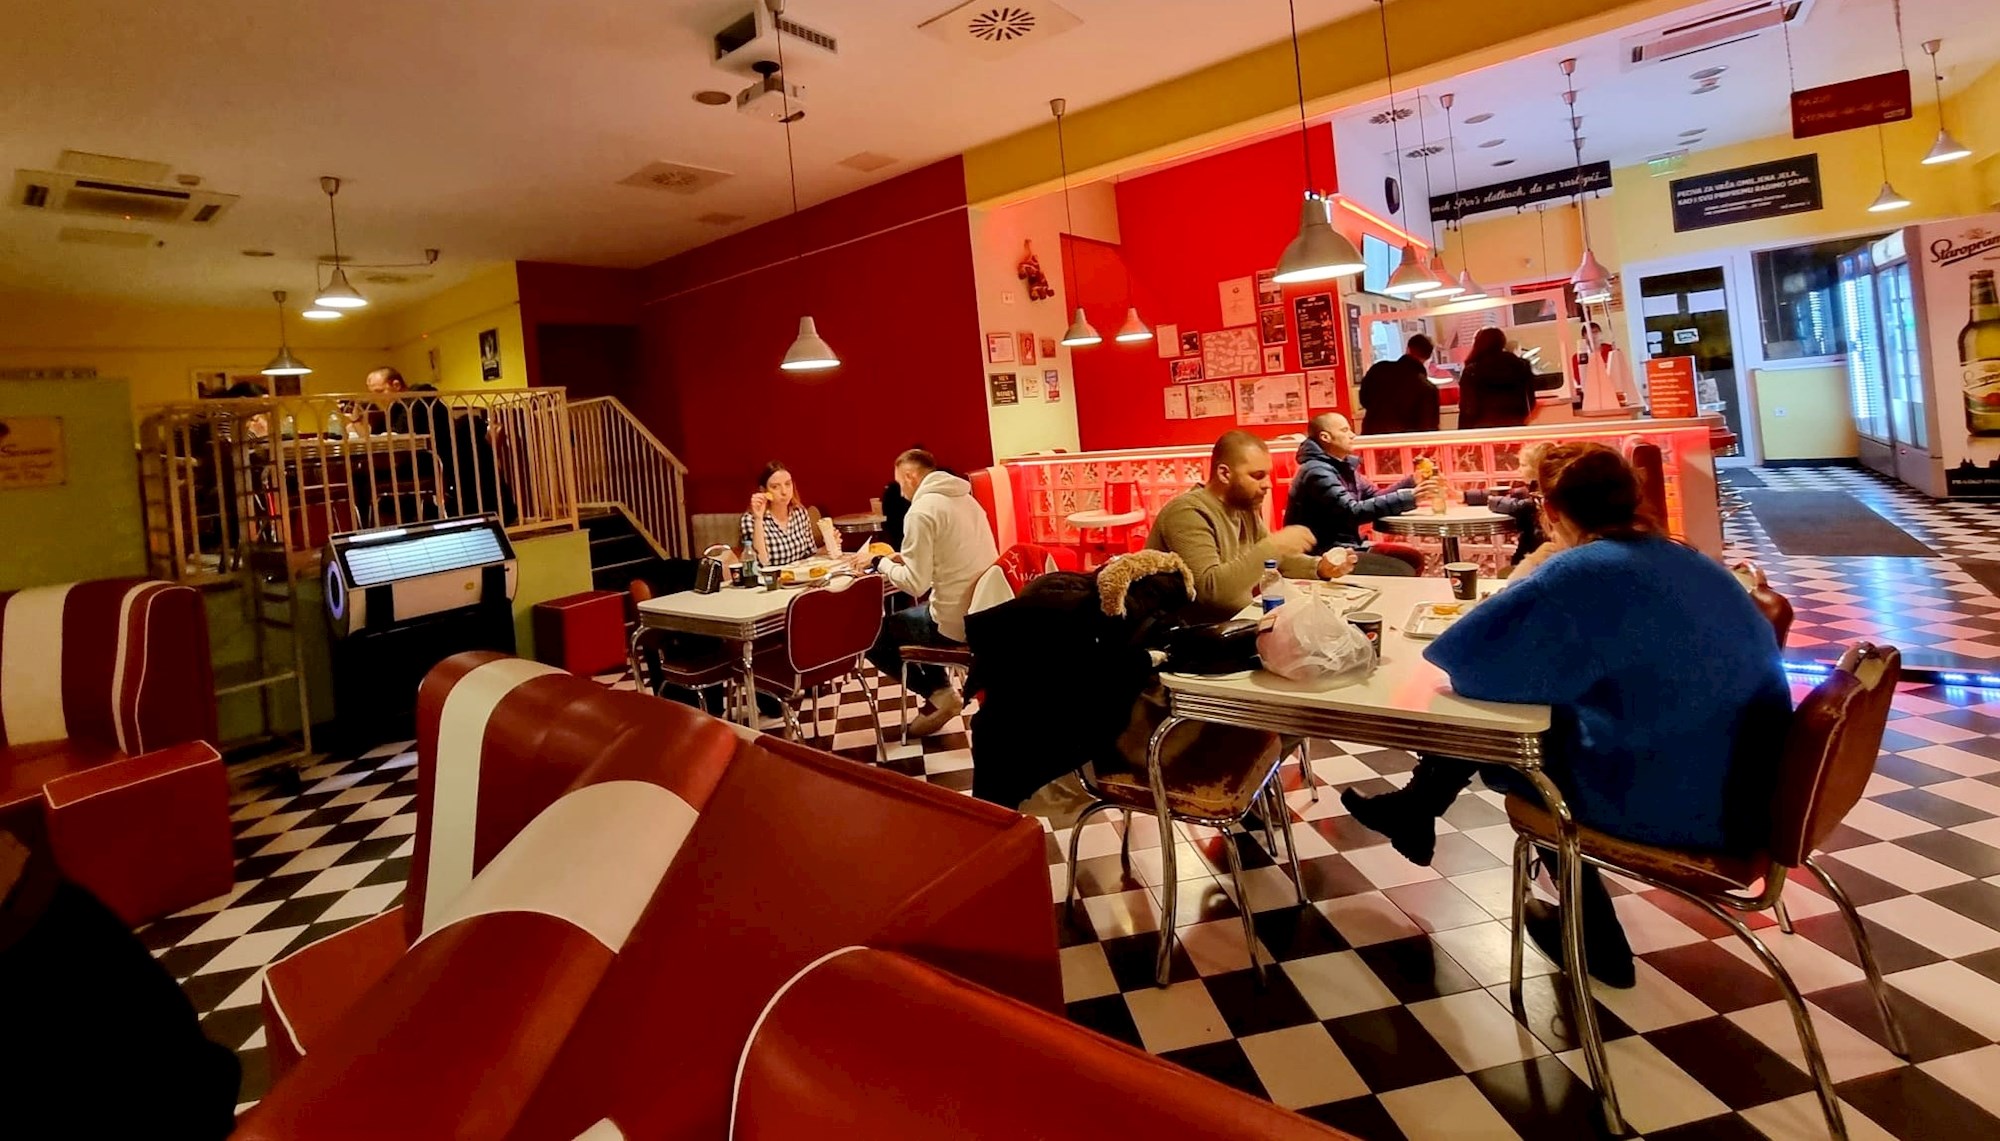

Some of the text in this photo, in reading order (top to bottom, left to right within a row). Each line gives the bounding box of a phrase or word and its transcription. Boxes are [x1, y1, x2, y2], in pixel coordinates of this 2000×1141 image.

[1529, 183, 1542, 194] da
[1703, 185, 1714, 193] ZA
[1735, 175, 1775, 187] OMILJENA
[1677, 197, 1693, 206] KAO
